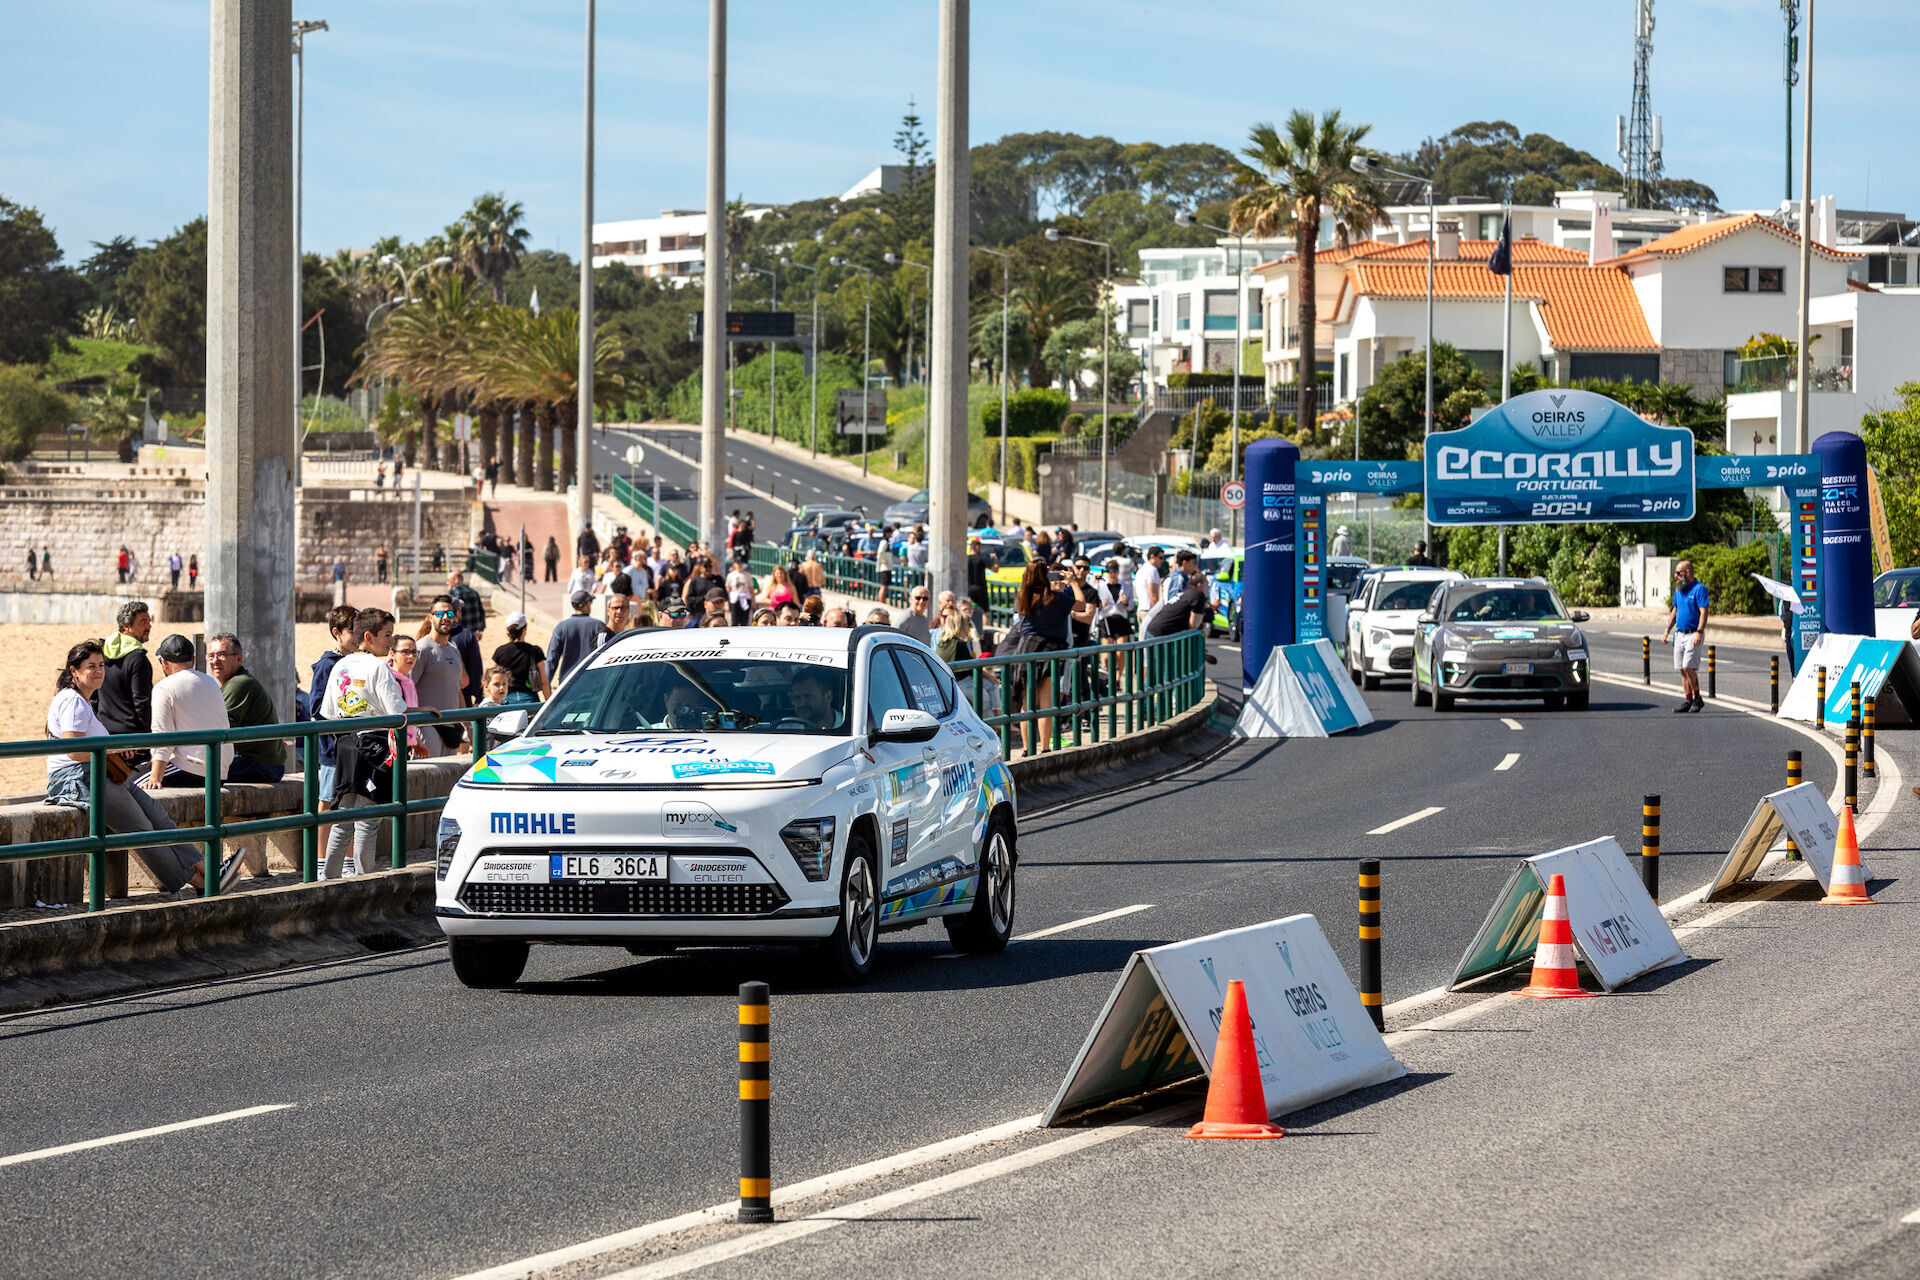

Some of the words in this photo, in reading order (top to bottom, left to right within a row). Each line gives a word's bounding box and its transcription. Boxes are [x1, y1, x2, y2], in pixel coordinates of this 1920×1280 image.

[1531, 411, 1585, 423] OEIRAS
[1532, 424, 1586, 437] VALLEY
[1323, 469, 1352, 483] prio
[1367, 471, 1397, 479] OEIRAS
[1721, 467, 1751, 475] OEIRAS
[1778, 462, 1807, 478] prio
[1367, 479, 1397, 487] VALLEY
[1516, 480, 1603, 491] PORTUGAL
[1226, 489, 1243, 500] 50
[1531, 502, 1592, 515] 2024
[1653, 497, 1681, 512] prio
[1825, 506, 1845, 514] RALLY
[603, 649, 728, 665] BRIDGESTONE
[747, 650, 834, 664] ENLITEN
[564, 747, 718, 755] HYUNDAI
[943, 761, 977, 797] MAHLE
[490, 812, 577, 834] MAHLE
[665, 811, 714, 825] mybox
[483, 862, 532, 871] BRIDGESTONE
[566, 857, 600, 876] EL6
[613, 857, 658, 877] 36CA
[690, 863, 748, 872] BRIDGESTONE
[487, 873, 529, 881] ENLITEN
[1284, 982, 1328, 1017] OEIRAS
[1301, 1016, 1346, 1051] VALLEY
